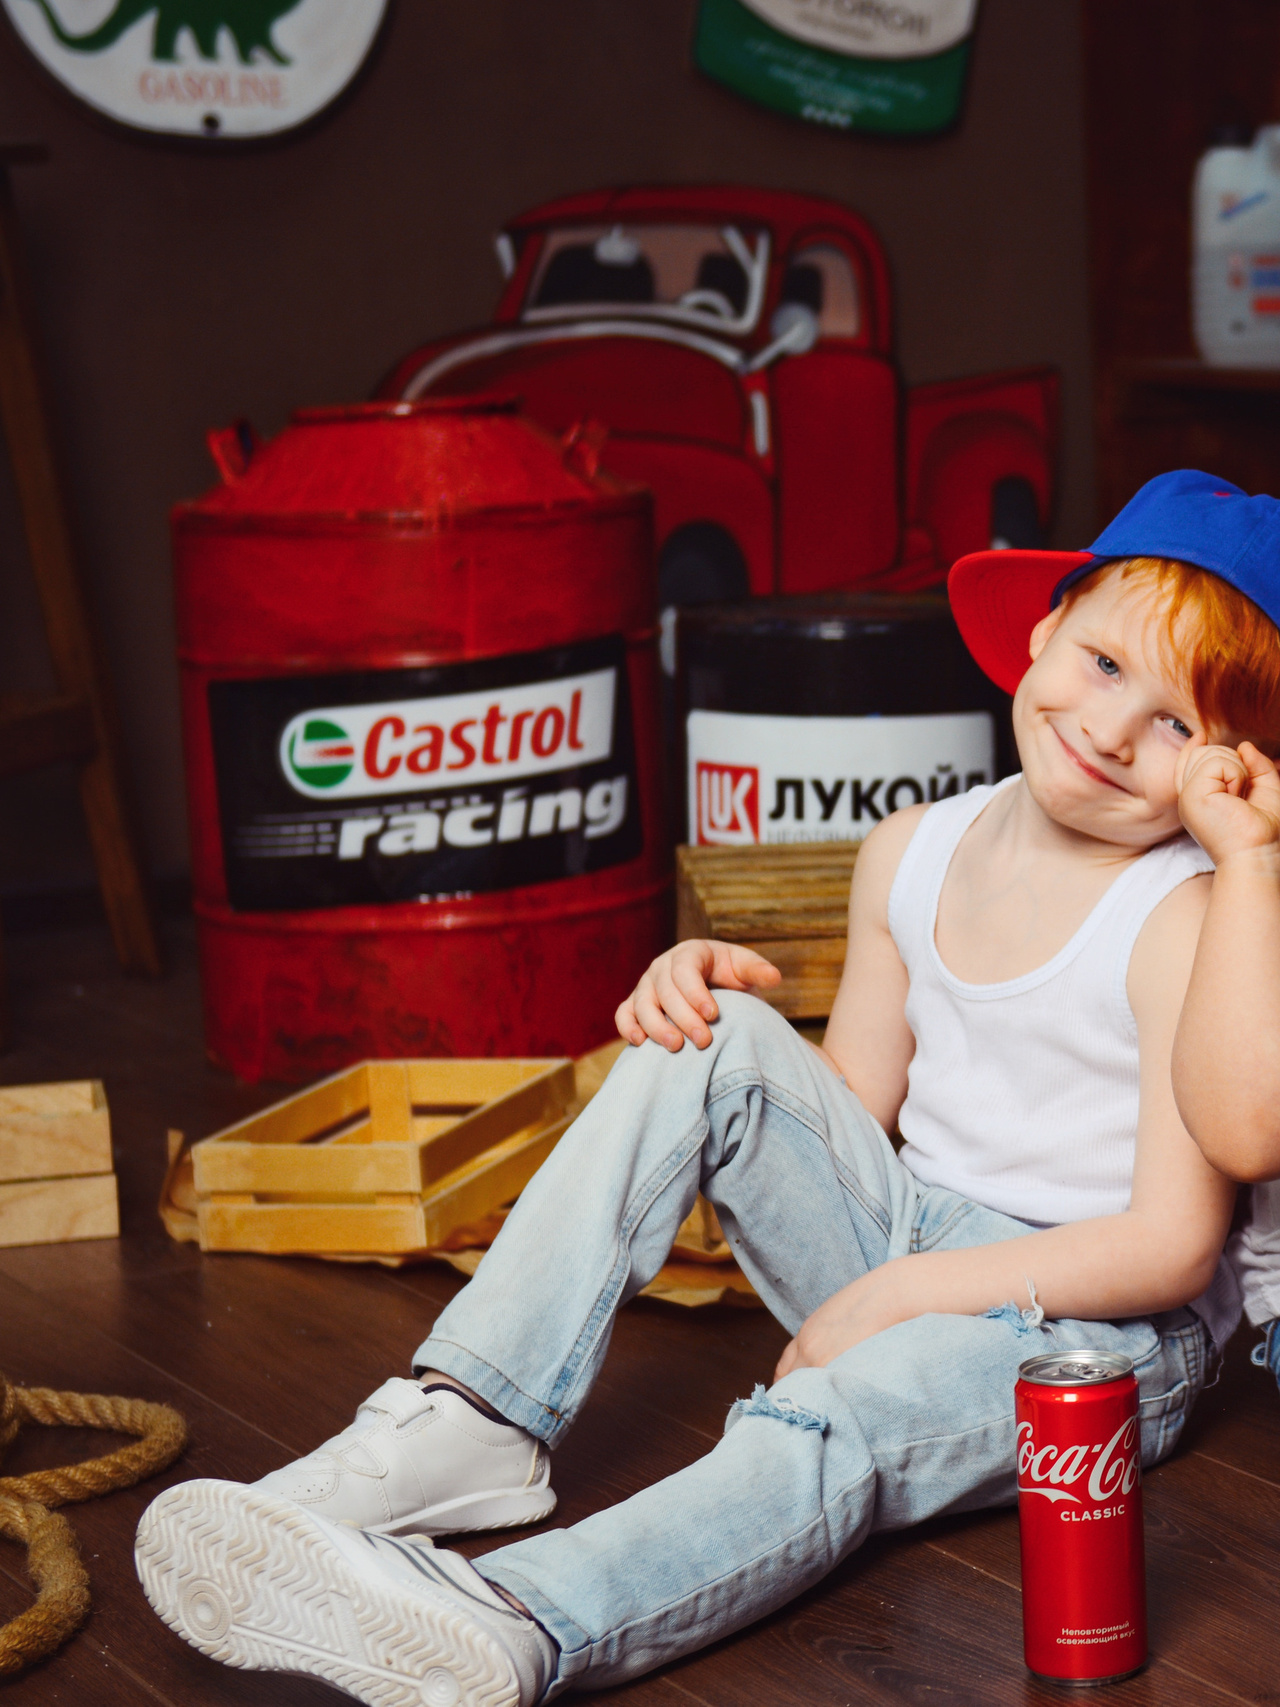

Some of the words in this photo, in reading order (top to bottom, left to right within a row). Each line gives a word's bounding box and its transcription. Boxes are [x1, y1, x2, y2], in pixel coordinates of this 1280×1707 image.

[139, 70, 286, 108] GASOLINE
[363, 688, 584, 780] Castrol
[337, 775, 627, 860] racing
[1060, 1504, 1125, 1522] CLASSIC
[1056, 1633, 1118, 1645] освежающий
[1061, 1620, 1129, 1636] Неповторимый
